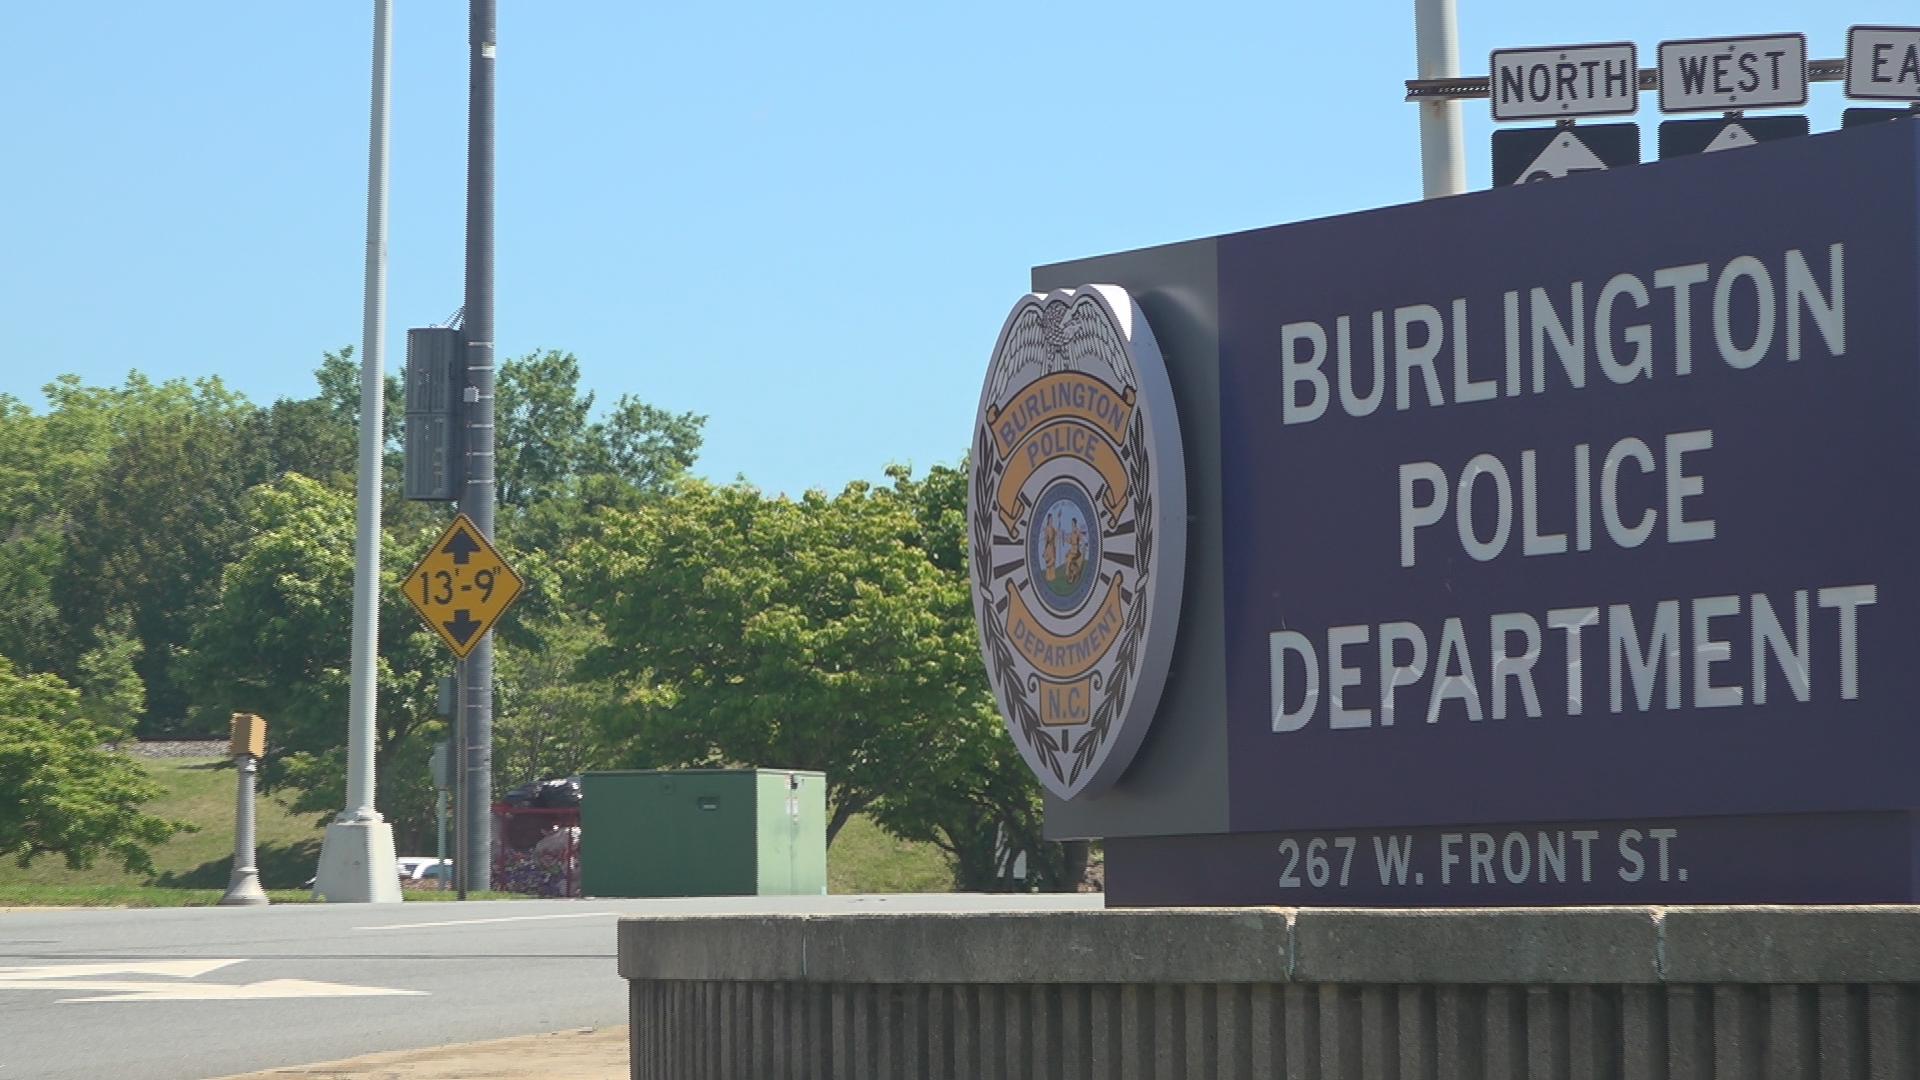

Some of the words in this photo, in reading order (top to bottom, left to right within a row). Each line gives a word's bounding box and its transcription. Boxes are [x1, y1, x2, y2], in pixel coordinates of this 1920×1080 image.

[1500, 59, 1628, 103] NORTH
[1679, 51, 1786, 95] WEST
[1281, 242, 1846, 425] BURLINGTON
[999, 381, 1125, 449] BURLINGTON
[1027, 426, 1099, 469] POLICE
[1399, 429, 1716, 567] POLICE
[1013, 604, 1117, 667] DEPARTMENT
[1269, 584, 1877, 733] DEPARTMENT
[1048, 686, 1087, 719] N.C.
[1278, 836, 1357, 888] 267
[1373, 834, 1424, 886] W.
[1440, 829, 1600, 885] FRONT
[1617, 827, 1689, 883] ST.
